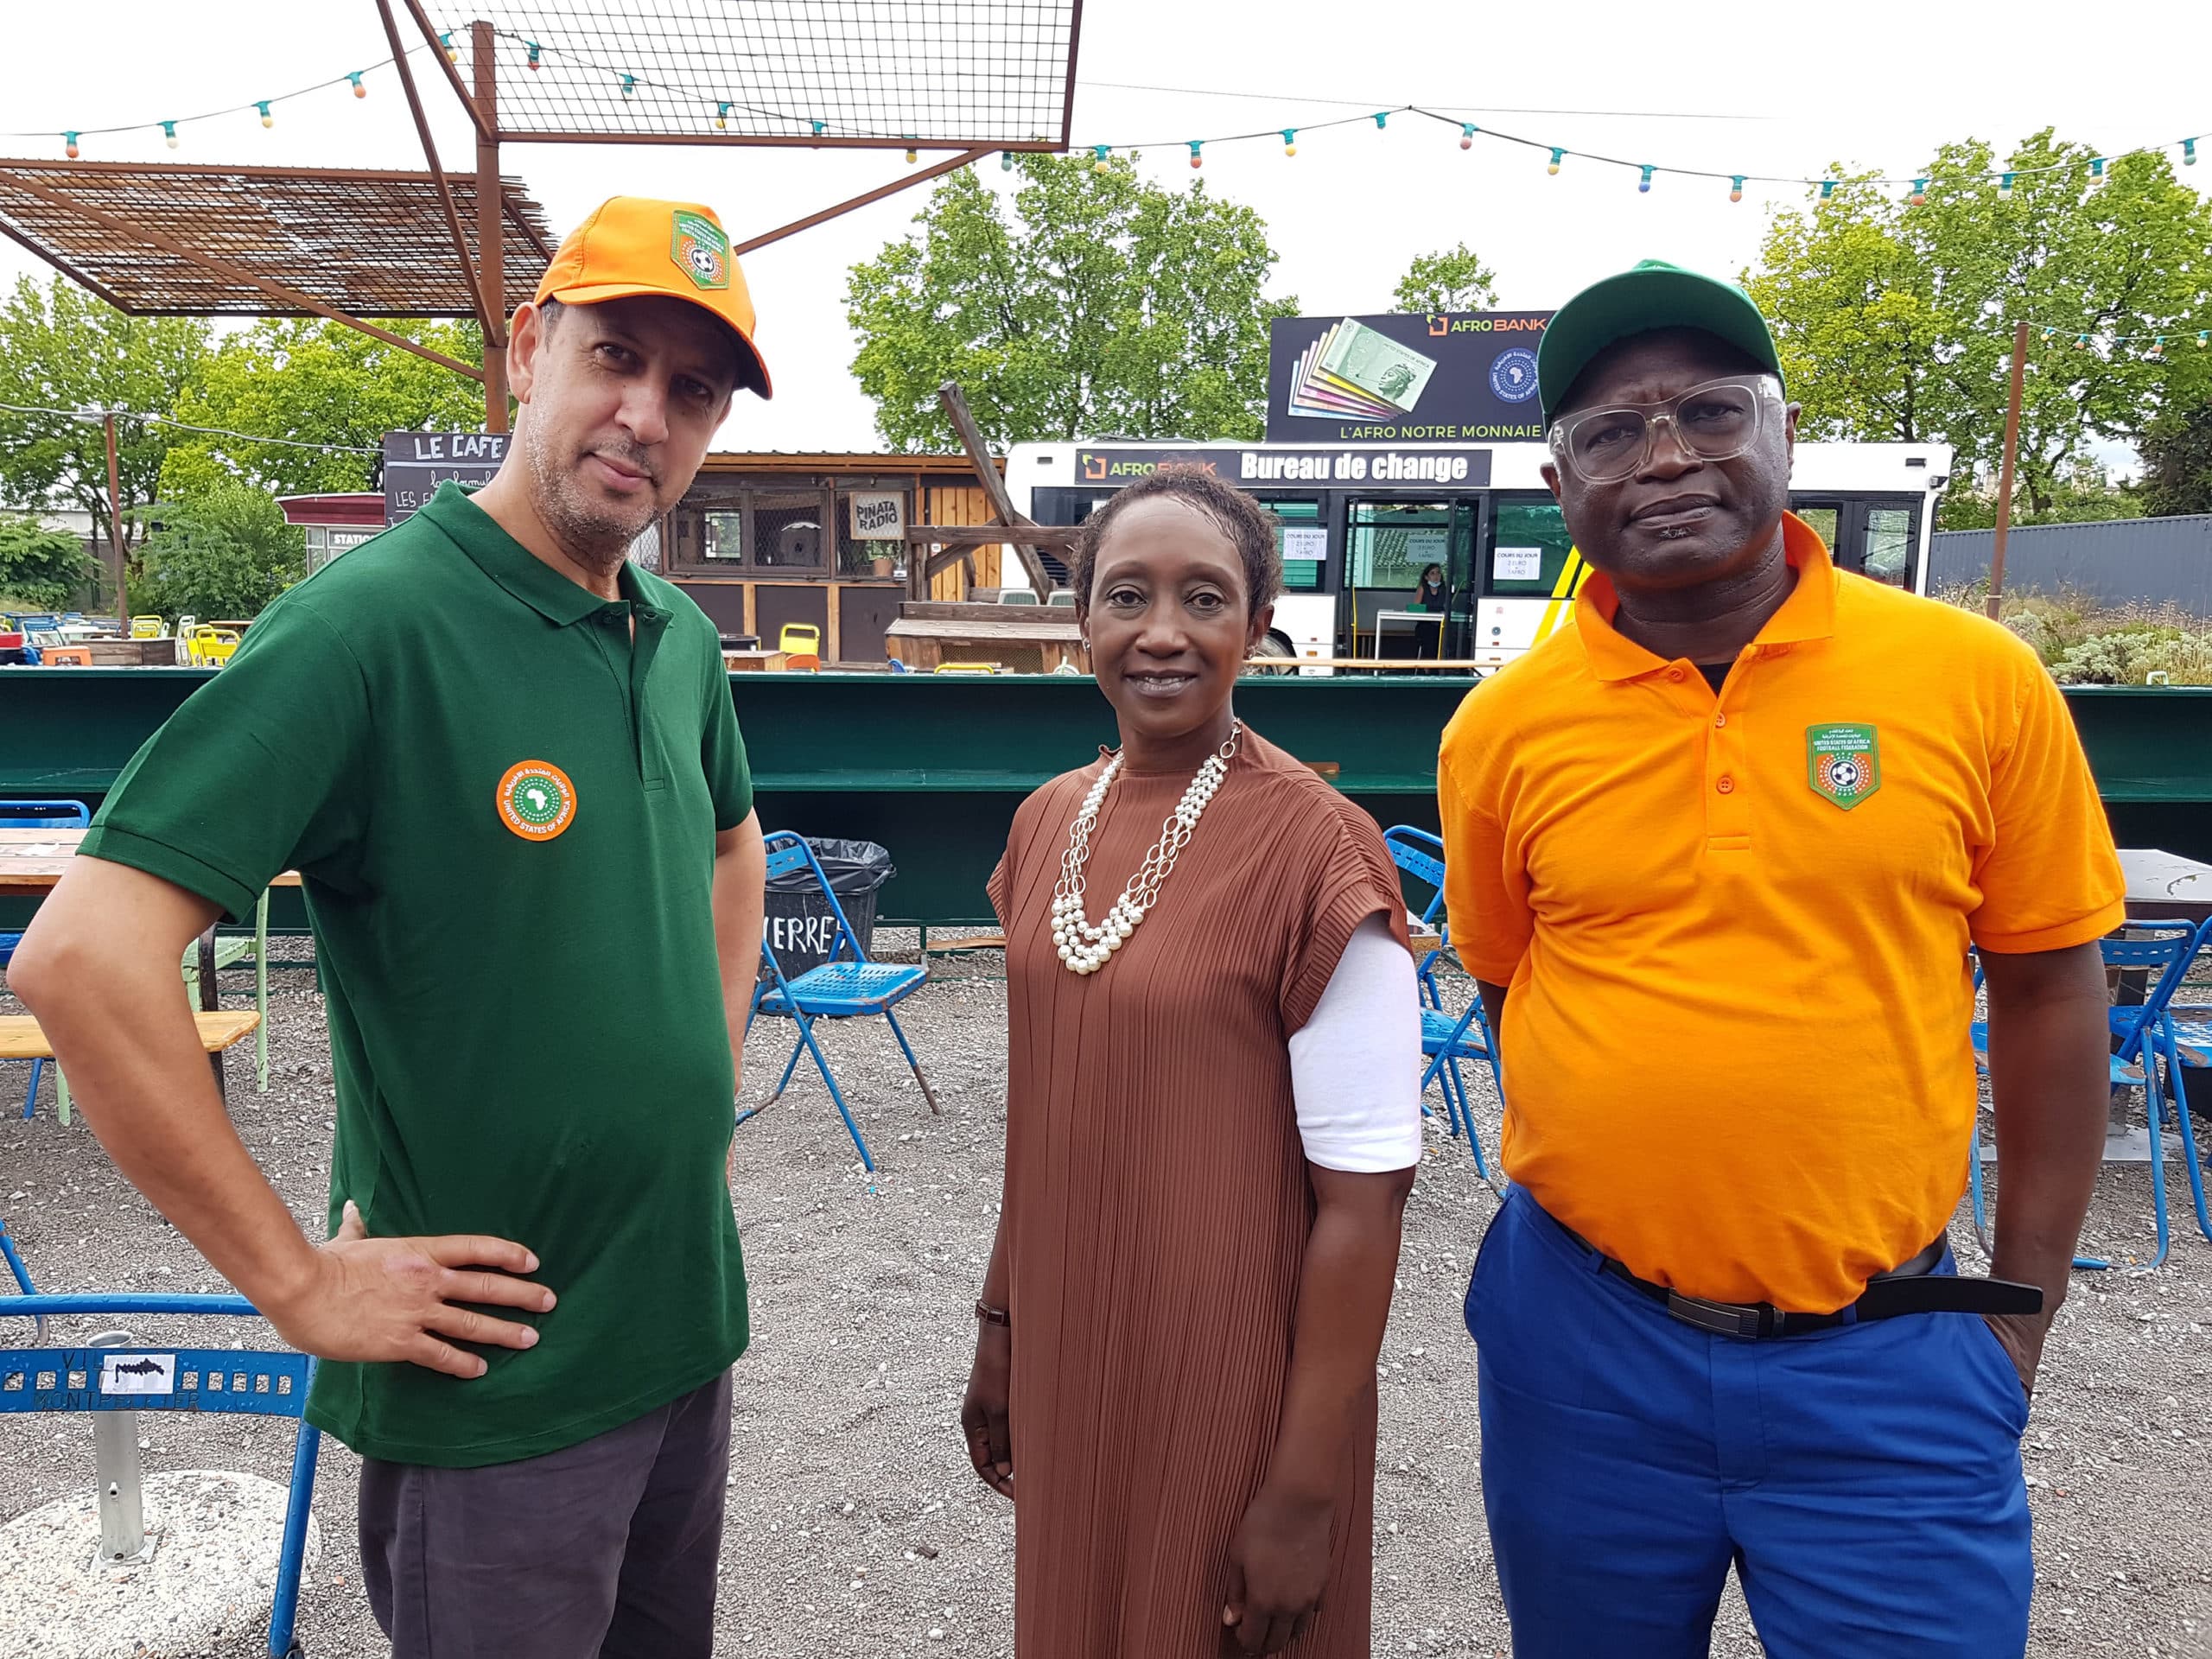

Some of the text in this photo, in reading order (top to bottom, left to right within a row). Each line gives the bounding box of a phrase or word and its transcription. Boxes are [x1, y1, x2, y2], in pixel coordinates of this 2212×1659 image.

[1402, 425, 1457, 439] NOTRE
[1462, 424, 1542, 438] MONNAIE
[414, 435, 445, 460] LE
[1240, 452, 1468, 483] Bureau de change
[395, 491, 416, 507] LES
[859, 512, 898, 531] RADIO
[334, 533, 375, 544] STATIO
[504, 799, 570, 835] UNITED STATES OF AFRICA
